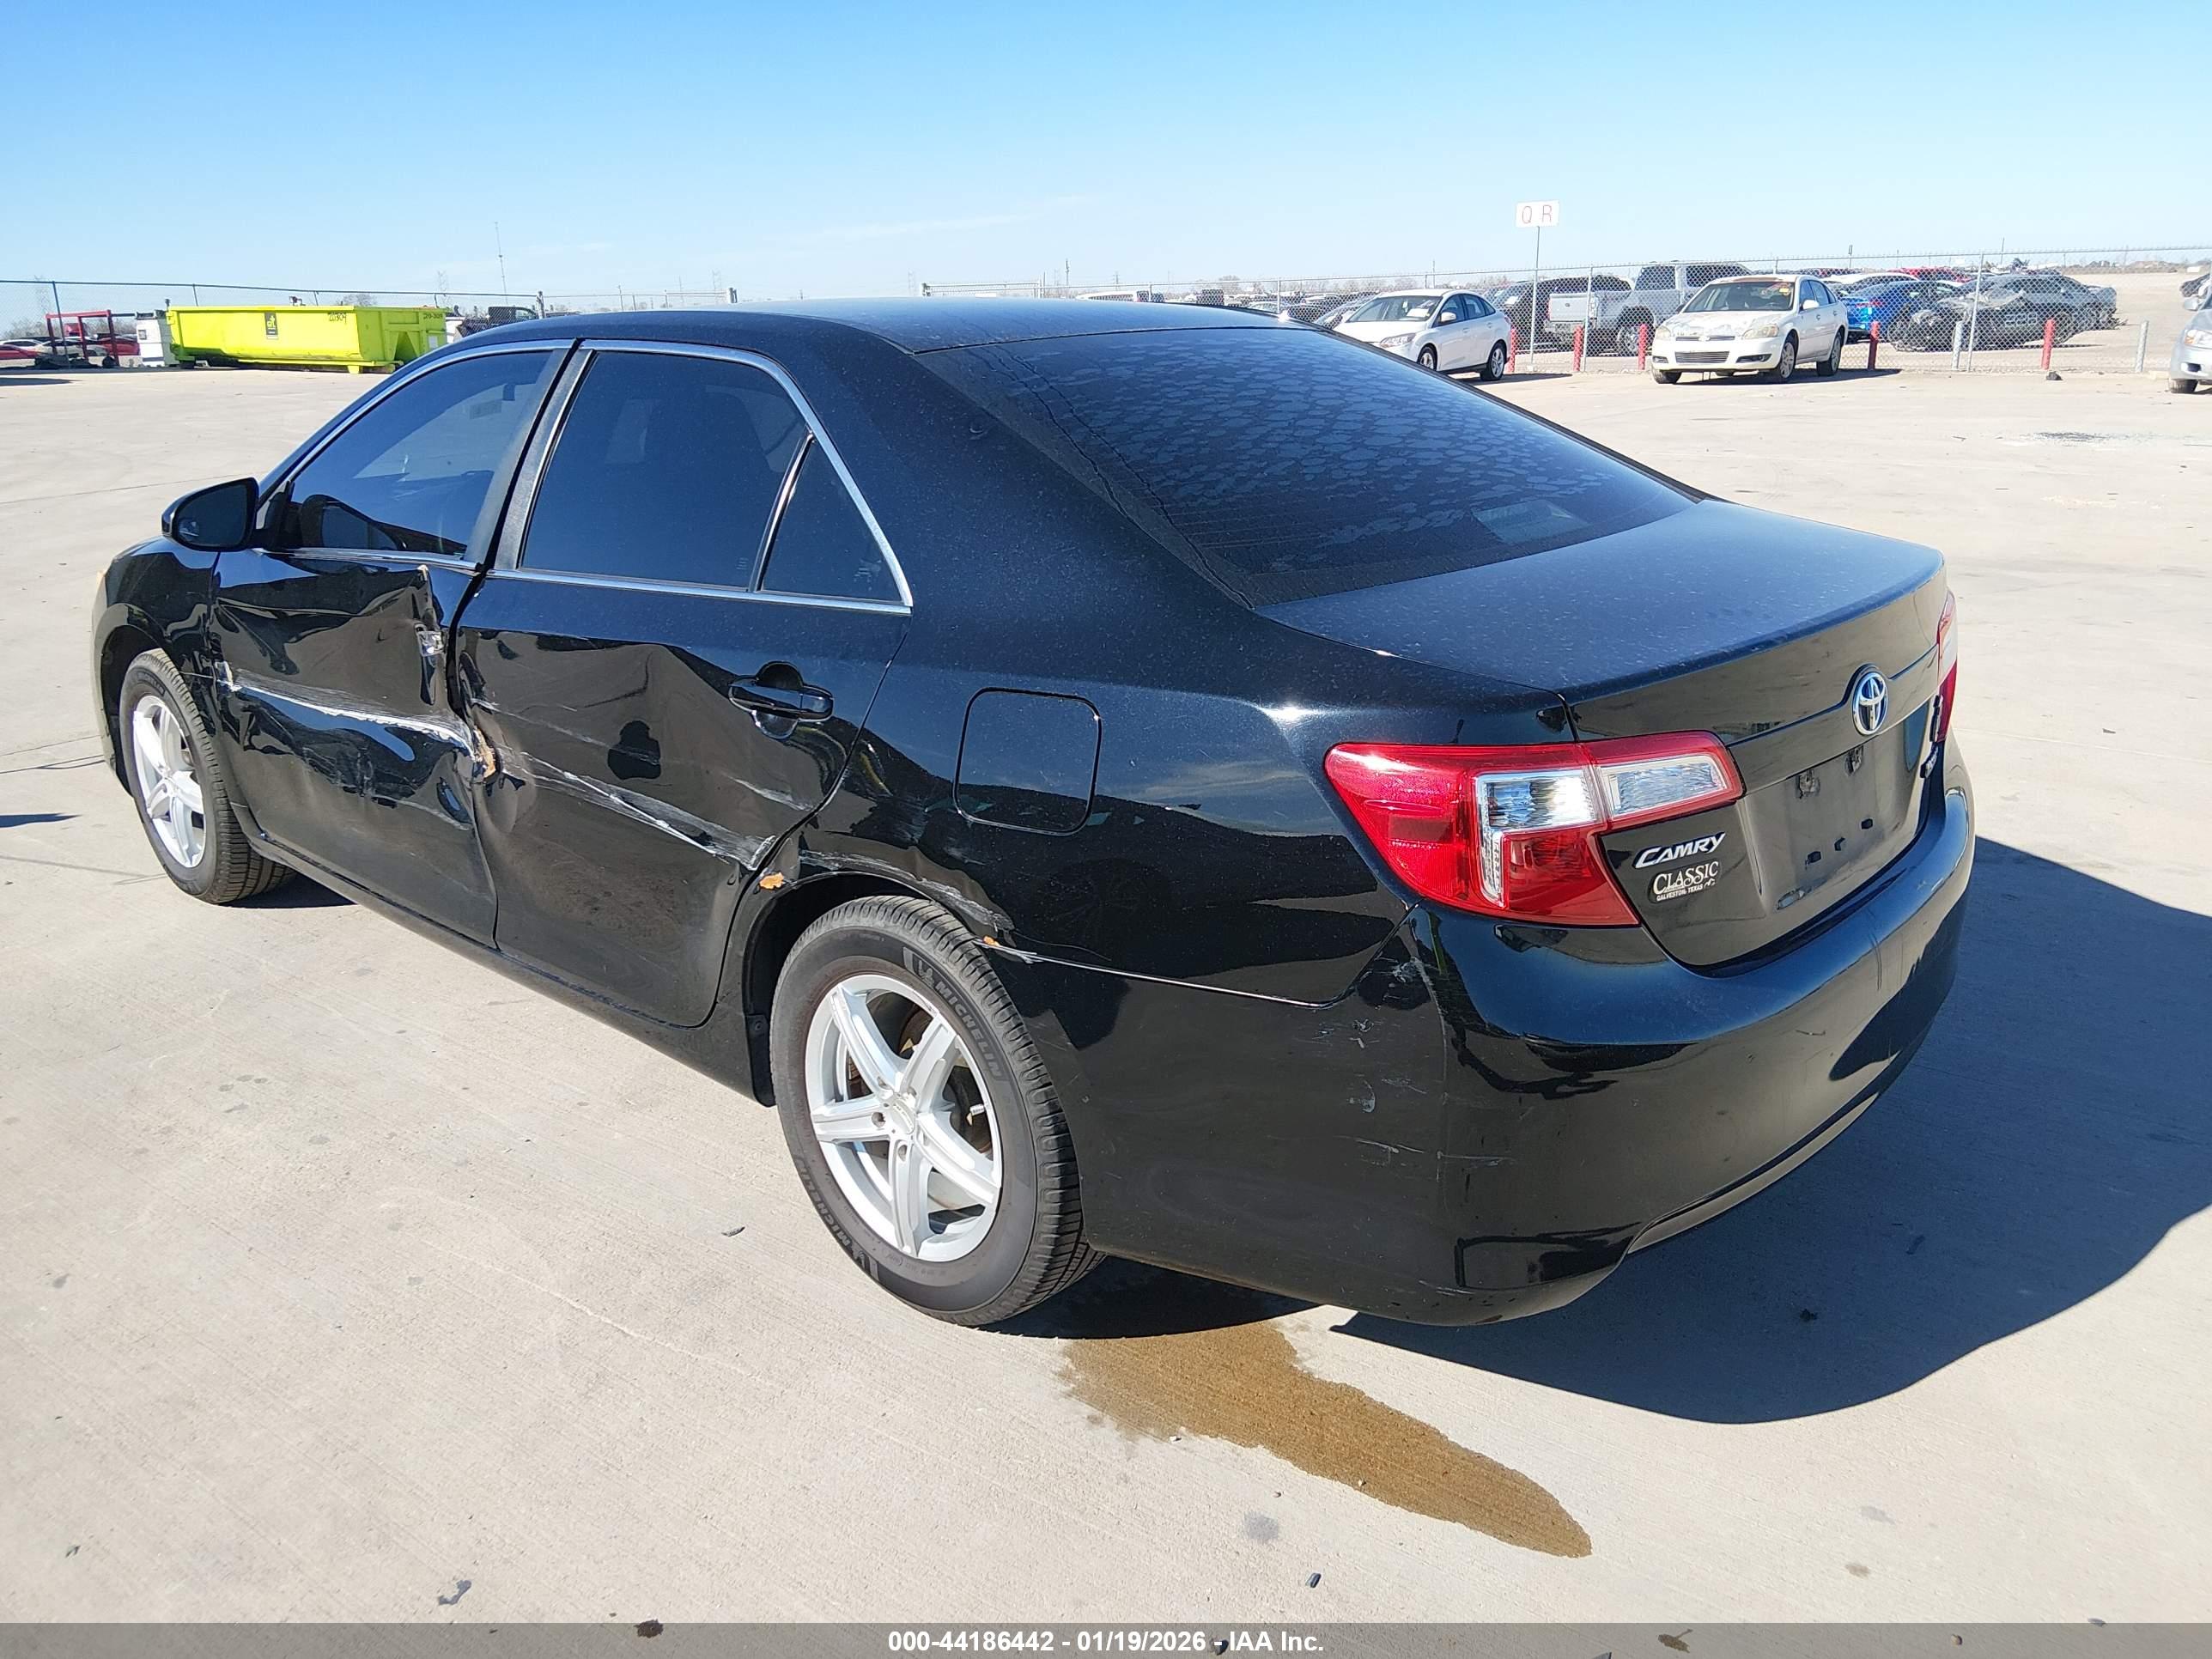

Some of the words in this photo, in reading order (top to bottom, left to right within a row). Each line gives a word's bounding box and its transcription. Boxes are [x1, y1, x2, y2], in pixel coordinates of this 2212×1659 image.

[1522, 205, 1532, 224] Q
[1541, 204, 1553, 222] R
[1633, 831, 1726, 869] CAMRY
[1653, 861, 1719, 895] CLASSIC
[1688, 884, 1703, 893] TEXAS
[935, 981, 1004, 1079] MICHELIN
